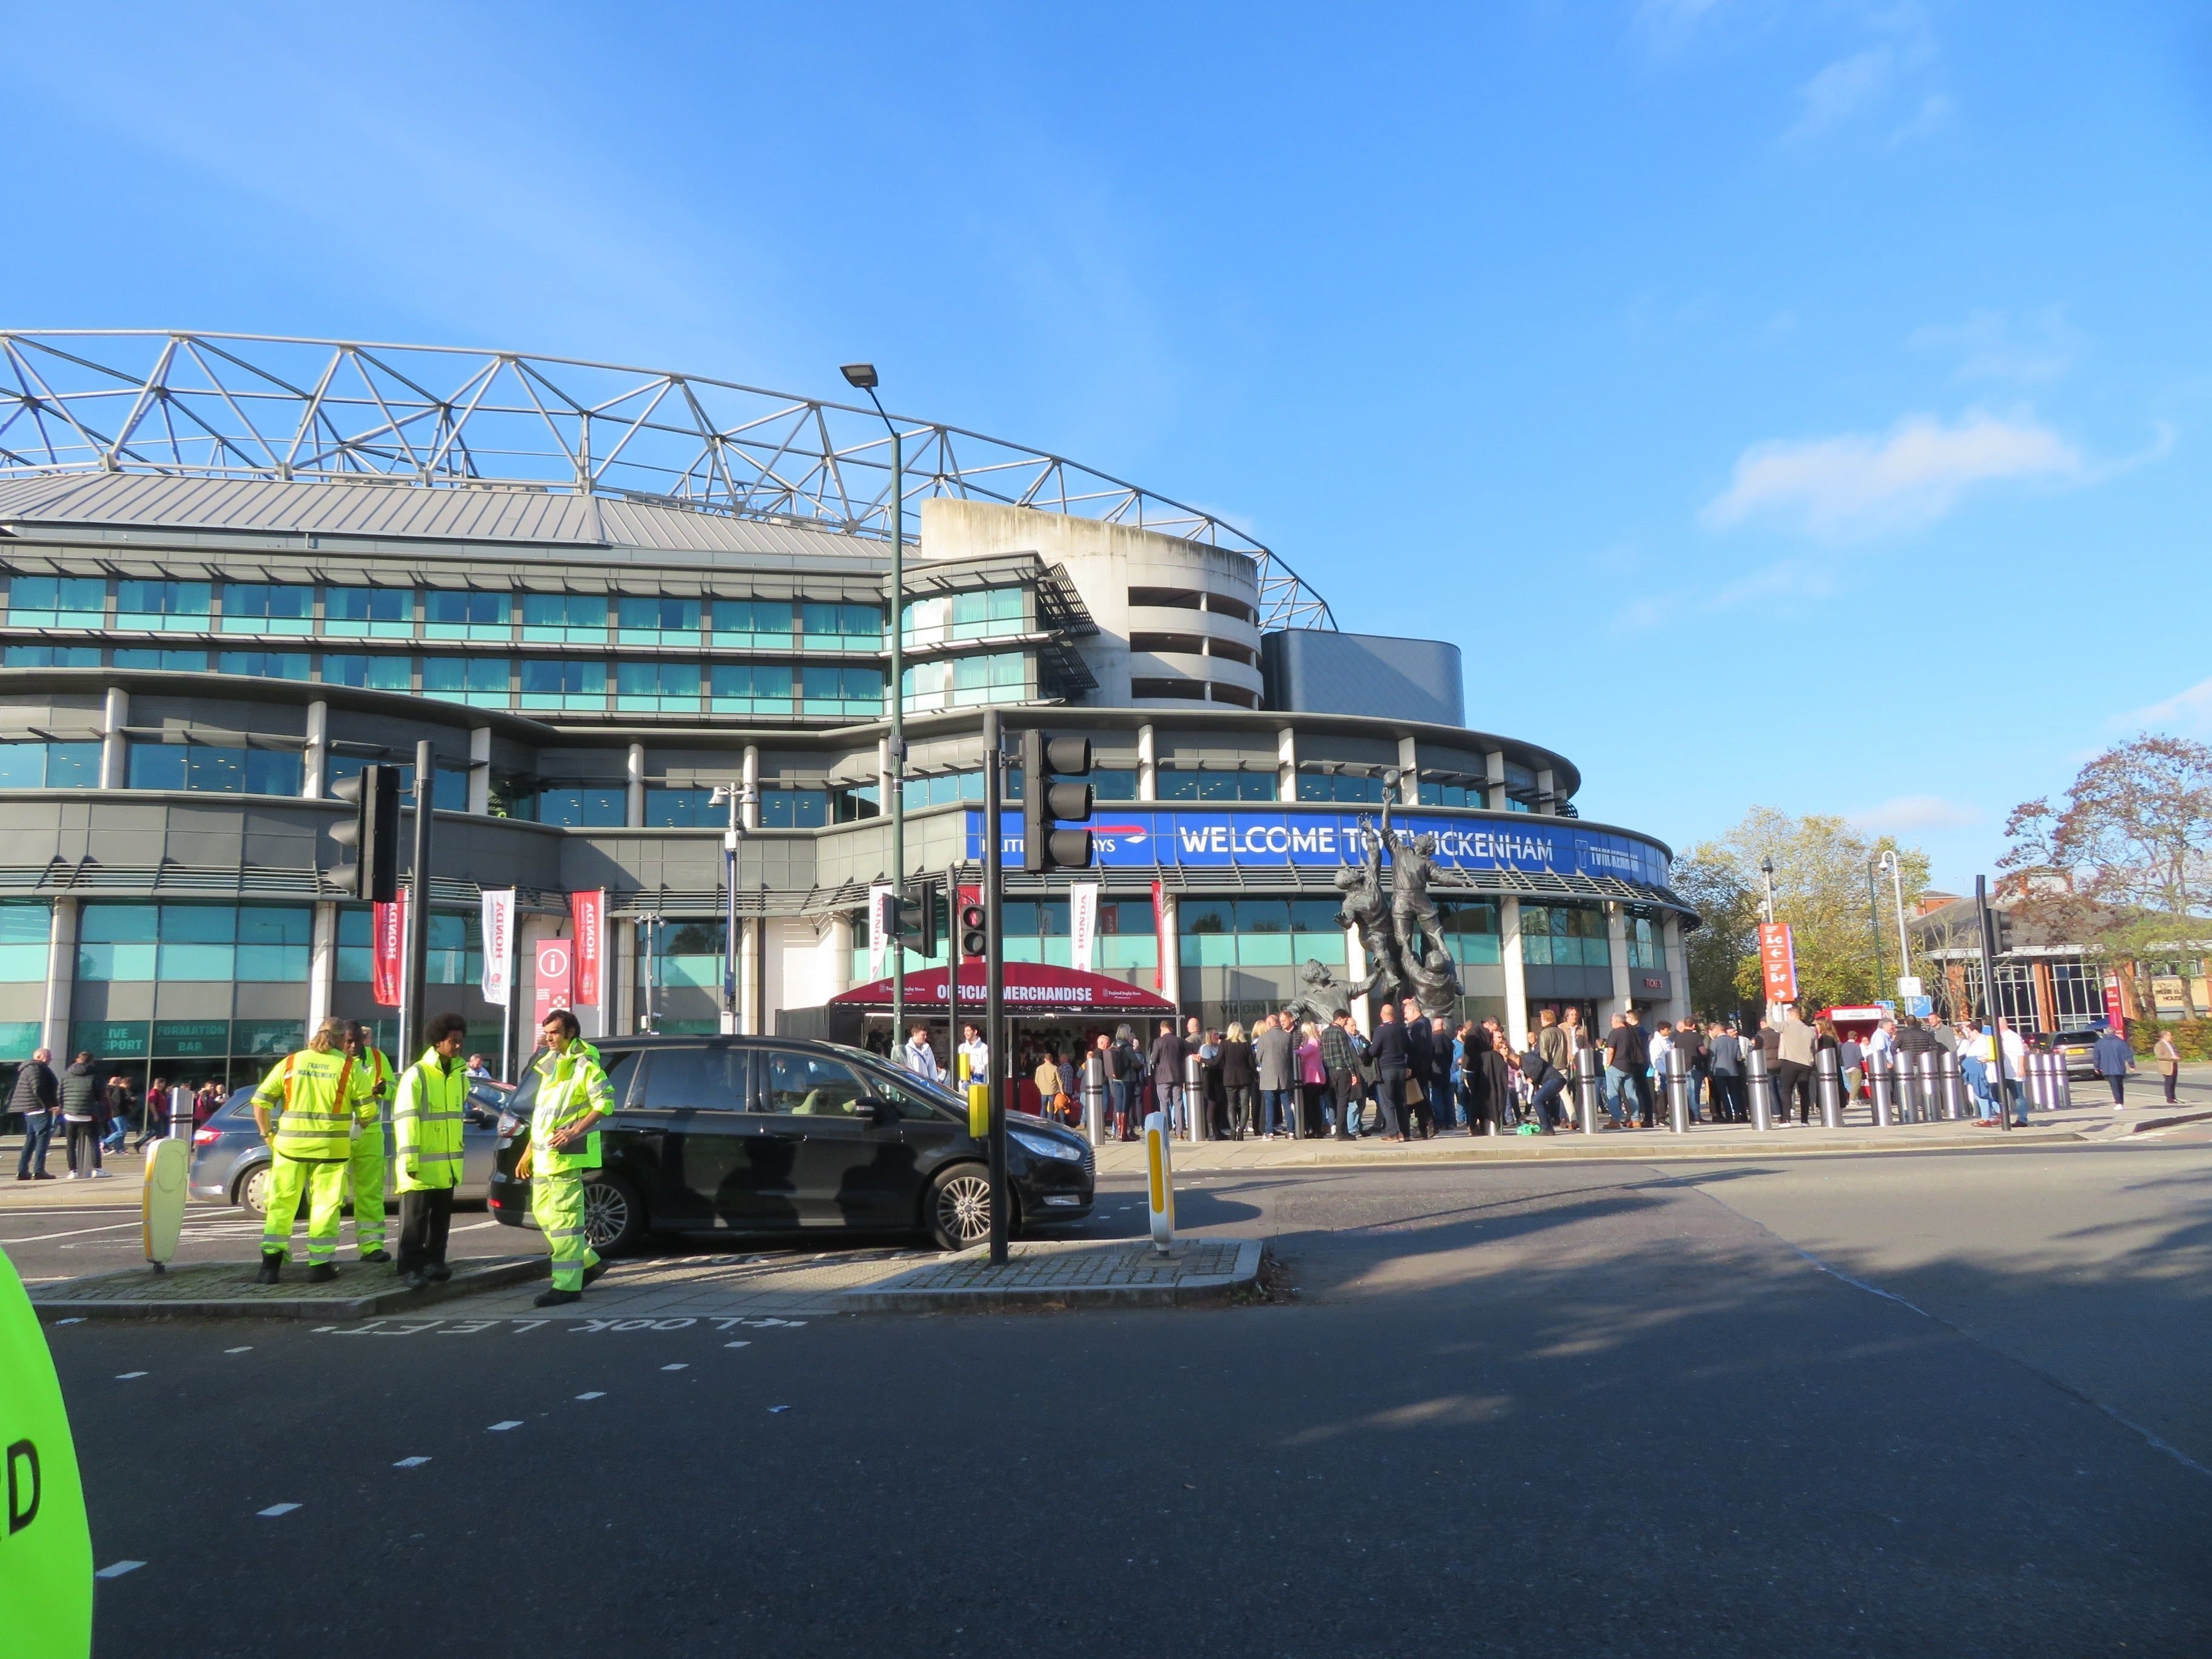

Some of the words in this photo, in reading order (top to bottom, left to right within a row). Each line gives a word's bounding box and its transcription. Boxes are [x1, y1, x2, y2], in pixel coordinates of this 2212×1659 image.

[1179, 826, 1335, 853] WELCOME
[1393, 829, 1553, 862] TICKENHAM
[1589, 846, 1639, 872] TWICKENHAM
[873, 896, 885, 952] HONDA
[1078, 894, 1087, 949] HONDA
[1645, 978, 1663, 988] TICKETS
[1771, 974, 1787, 982] D-F
[1003, 986, 1093, 1001] MERCHANDISE
[102, 1028, 129, 1039] LIVE
[156, 1025, 226, 1036] FORMATION
[102, 1039, 143, 1050] SPORT
[178, 1042, 203, 1051] BAR
[306, 1062, 330, 1070] TRAFFIC
[298, 1069, 336, 1079] MANAGEMENT
[331, 1319, 551, 1335] LEFT
[568, 1317, 745, 1333] LOOK
